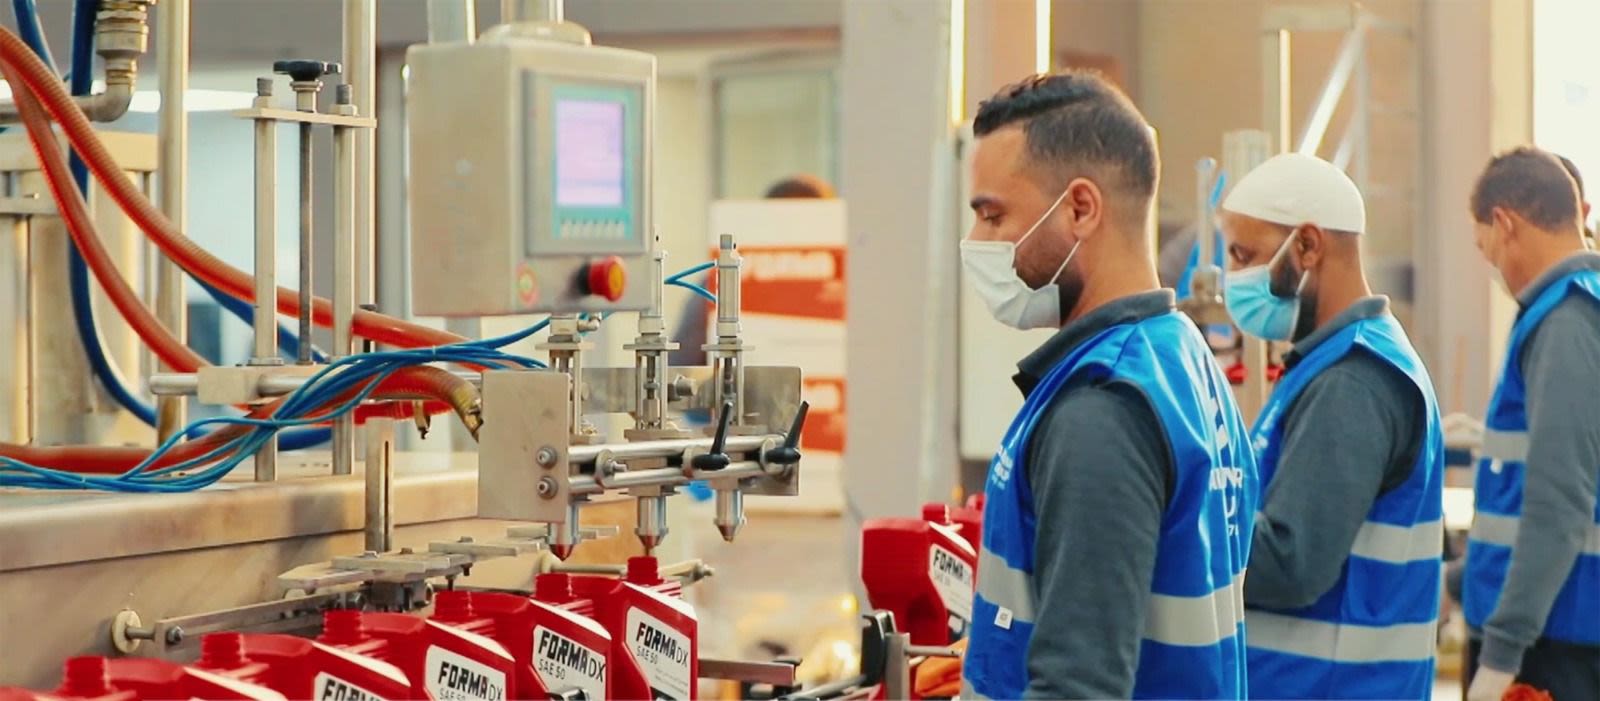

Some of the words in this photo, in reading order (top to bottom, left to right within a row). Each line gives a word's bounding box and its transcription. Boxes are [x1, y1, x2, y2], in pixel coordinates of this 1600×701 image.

[933, 548, 963, 579] FORMA
[537, 629, 589, 675] FORMA
[588, 656, 607, 683] DX
[636, 621, 677, 661] FORMA
[675, 647, 688, 669] DX
[636, 646, 650, 661] SAE
[437, 660, 489, 699] FORMA
[538, 658, 554, 675] SAE
[554, 664, 566, 680] 50
[321, 677, 381, 701] FOR
